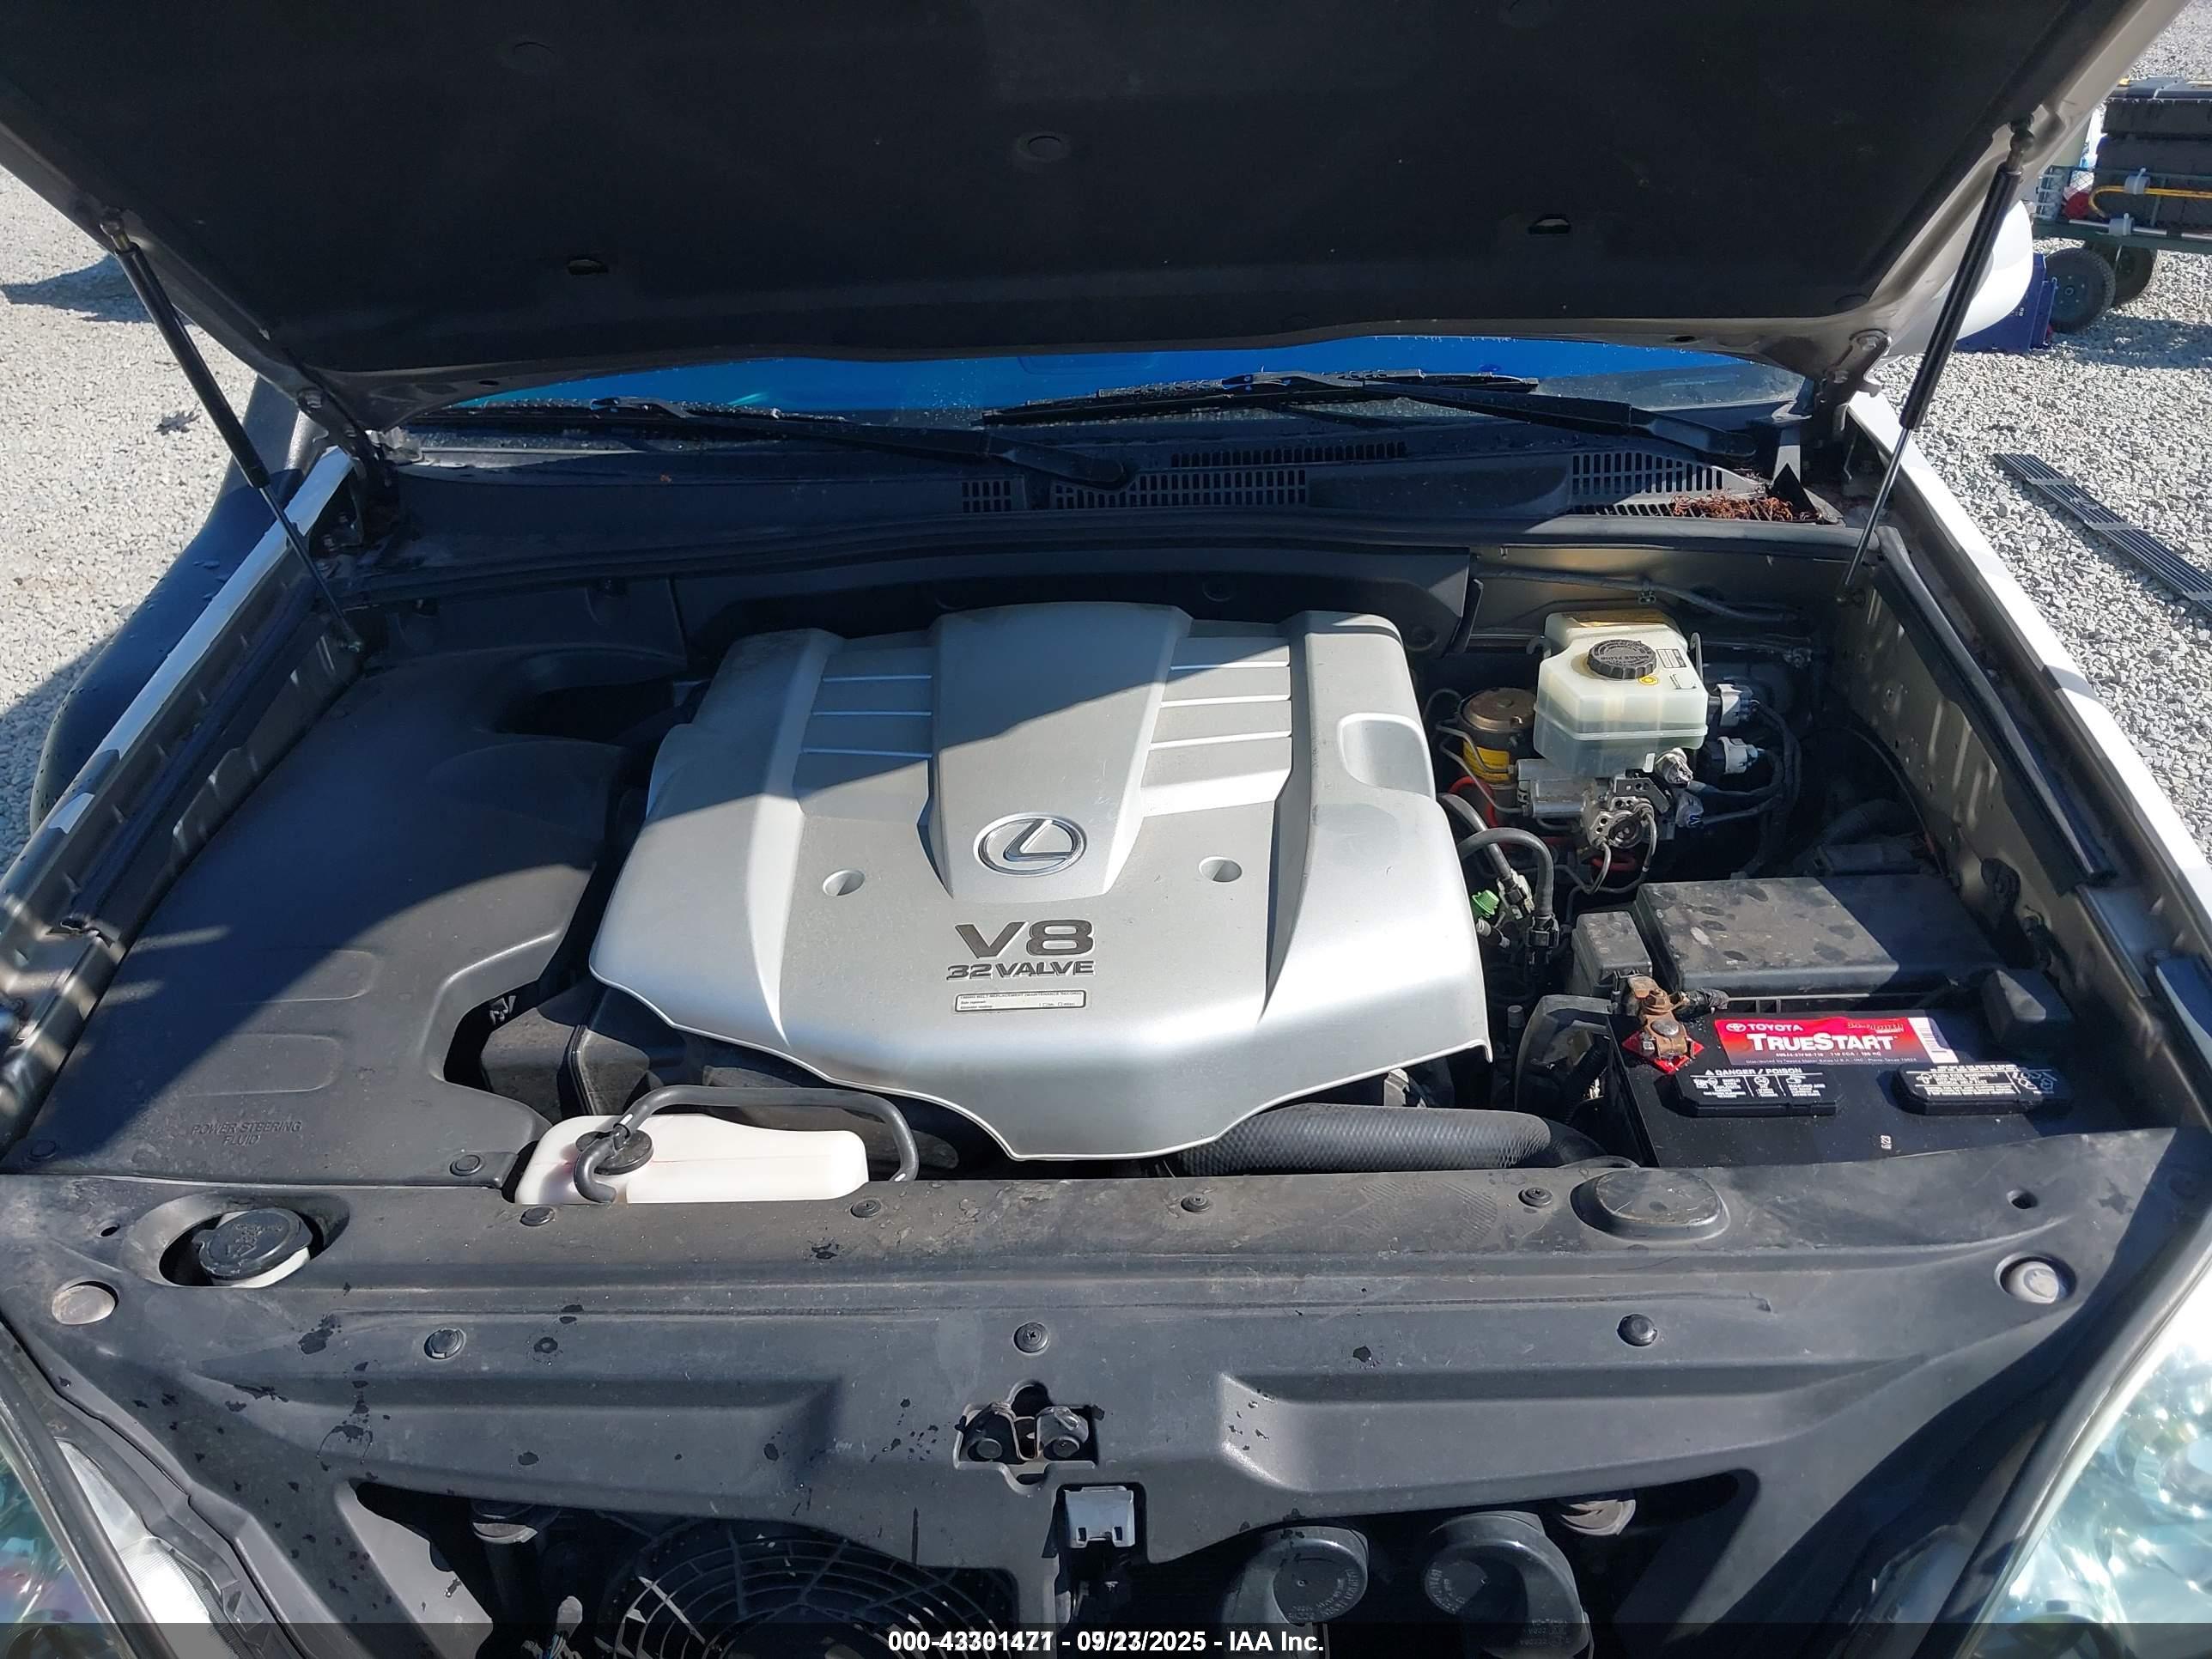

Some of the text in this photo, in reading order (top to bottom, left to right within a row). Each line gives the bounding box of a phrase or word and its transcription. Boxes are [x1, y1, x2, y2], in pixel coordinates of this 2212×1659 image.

[955, 919, 1094, 960] V8
[946, 960, 1095, 980] 32 VALVE
[1747, 1023, 1803, 1032] TOYOTA
[191, 1120, 302, 1135] POWER STEERING
[223, 1134, 261, 1146] FLUID
